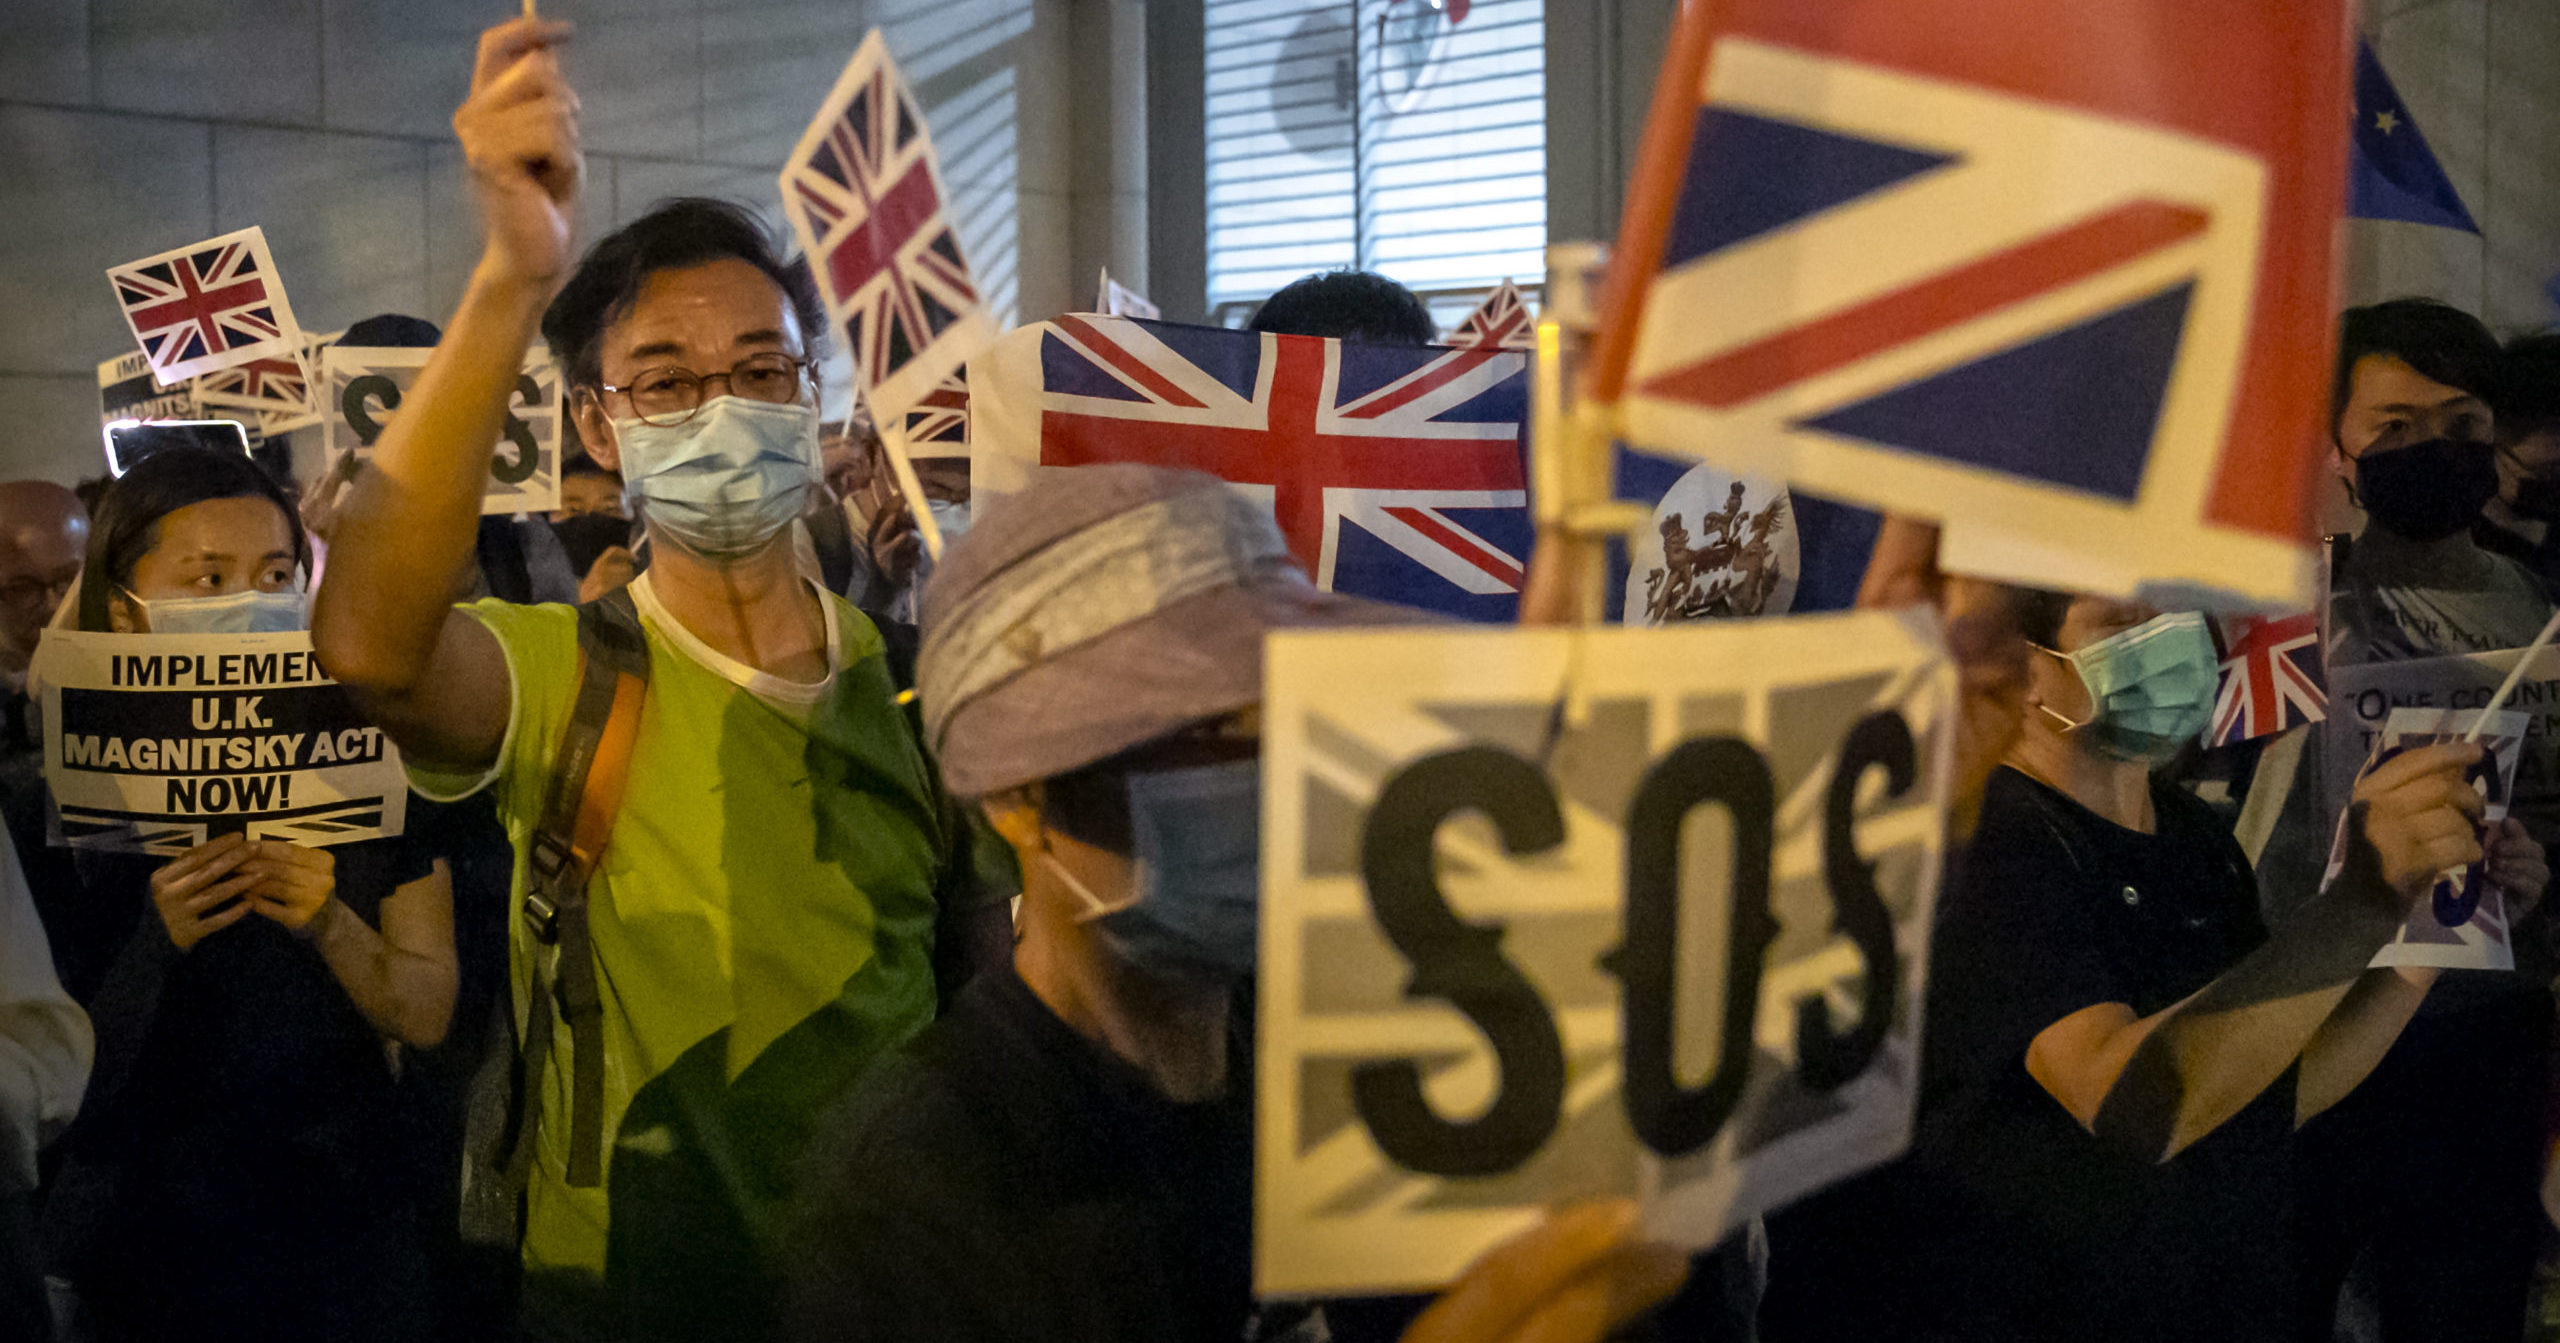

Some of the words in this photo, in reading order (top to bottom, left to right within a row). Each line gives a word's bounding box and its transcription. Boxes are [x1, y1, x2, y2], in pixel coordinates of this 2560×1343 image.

[342, 375, 542, 484] SS
[112, 651, 331, 686] IMPLEMEN
[191, 696, 274, 731] U.K.
[64, 733, 306, 771] MAGNITSKY
[308, 726, 383, 764] ACT
[166, 774, 292, 814] NOW!
[1350, 708, 1917, 1180] SOS
